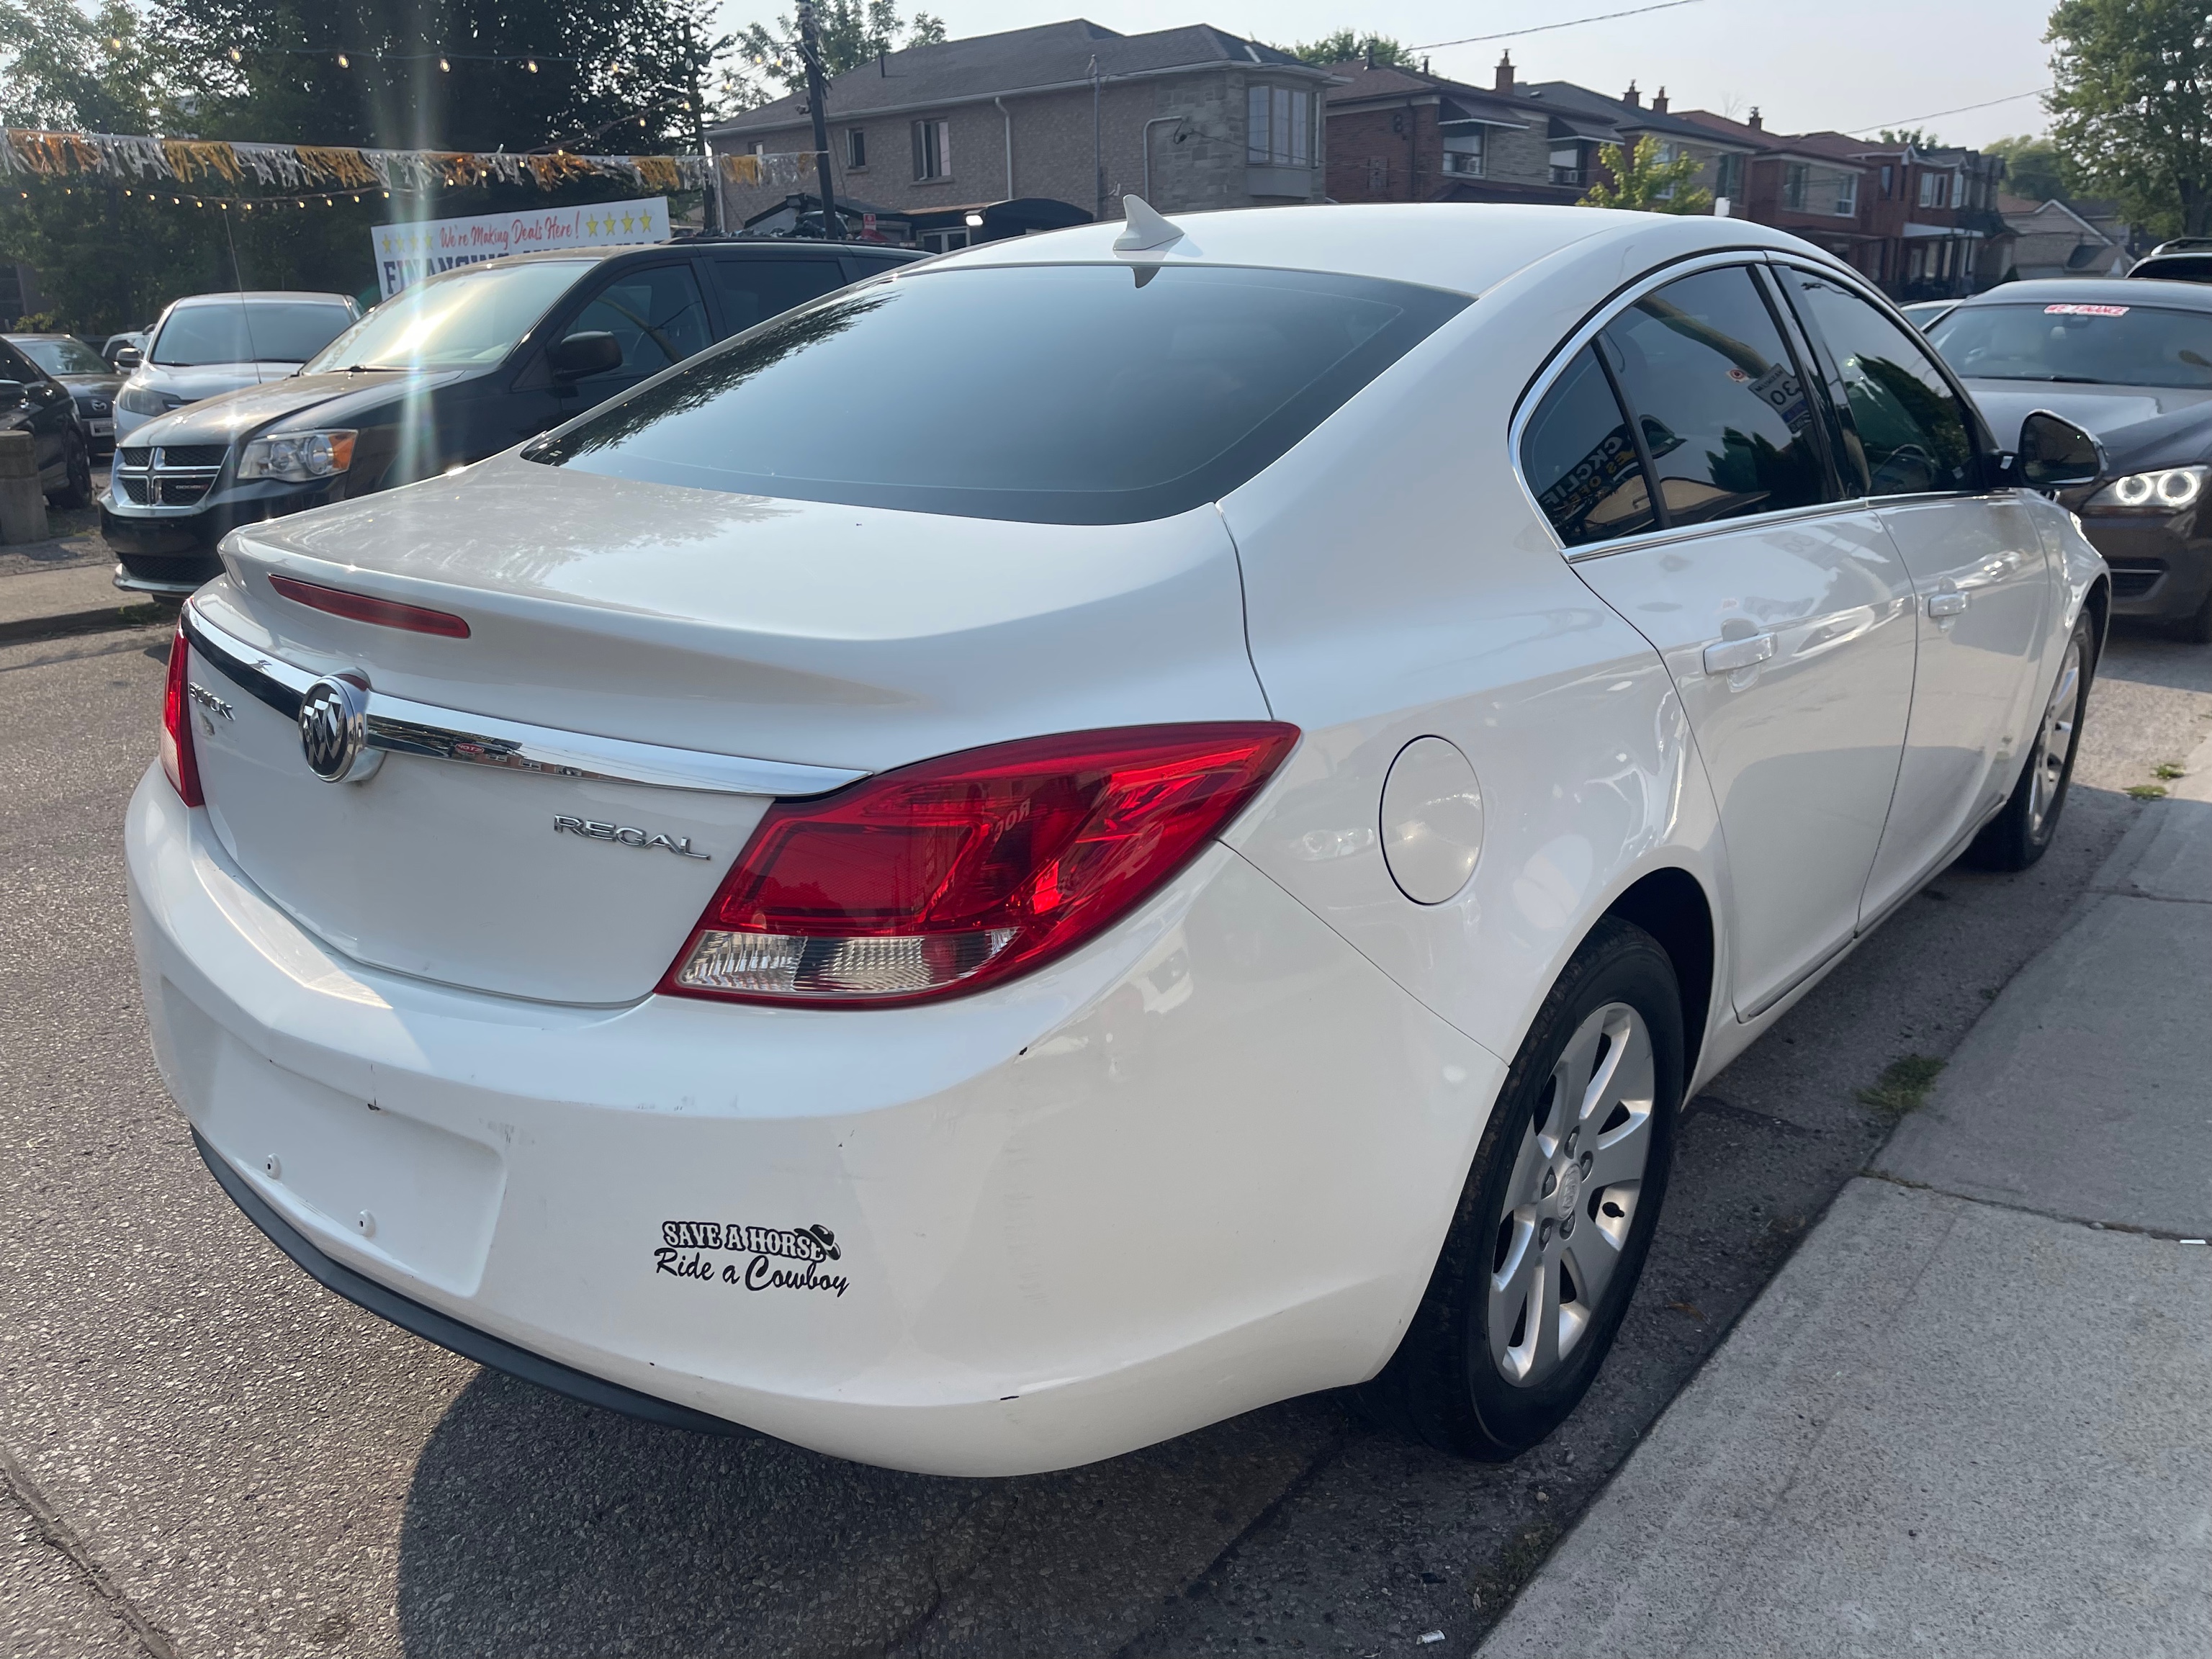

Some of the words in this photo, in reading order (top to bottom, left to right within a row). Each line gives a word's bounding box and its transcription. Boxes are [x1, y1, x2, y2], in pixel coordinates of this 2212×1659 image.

[439, 224, 468, 248] We're
[471, 224, 509, 251] Making
[511, 219, 542, 244] Deals
[545, 210, 580, 240] Here!
[554, 814, 712, 862] REGAL
[662, 1220, 722, 1249] SAVE
[724, 1224, 746, 1251] A
[654, 1247, 715, 1281] Ride
[722, 1264, 741, 1285] a
[745, 1255, 850, 1298] Cowboy
